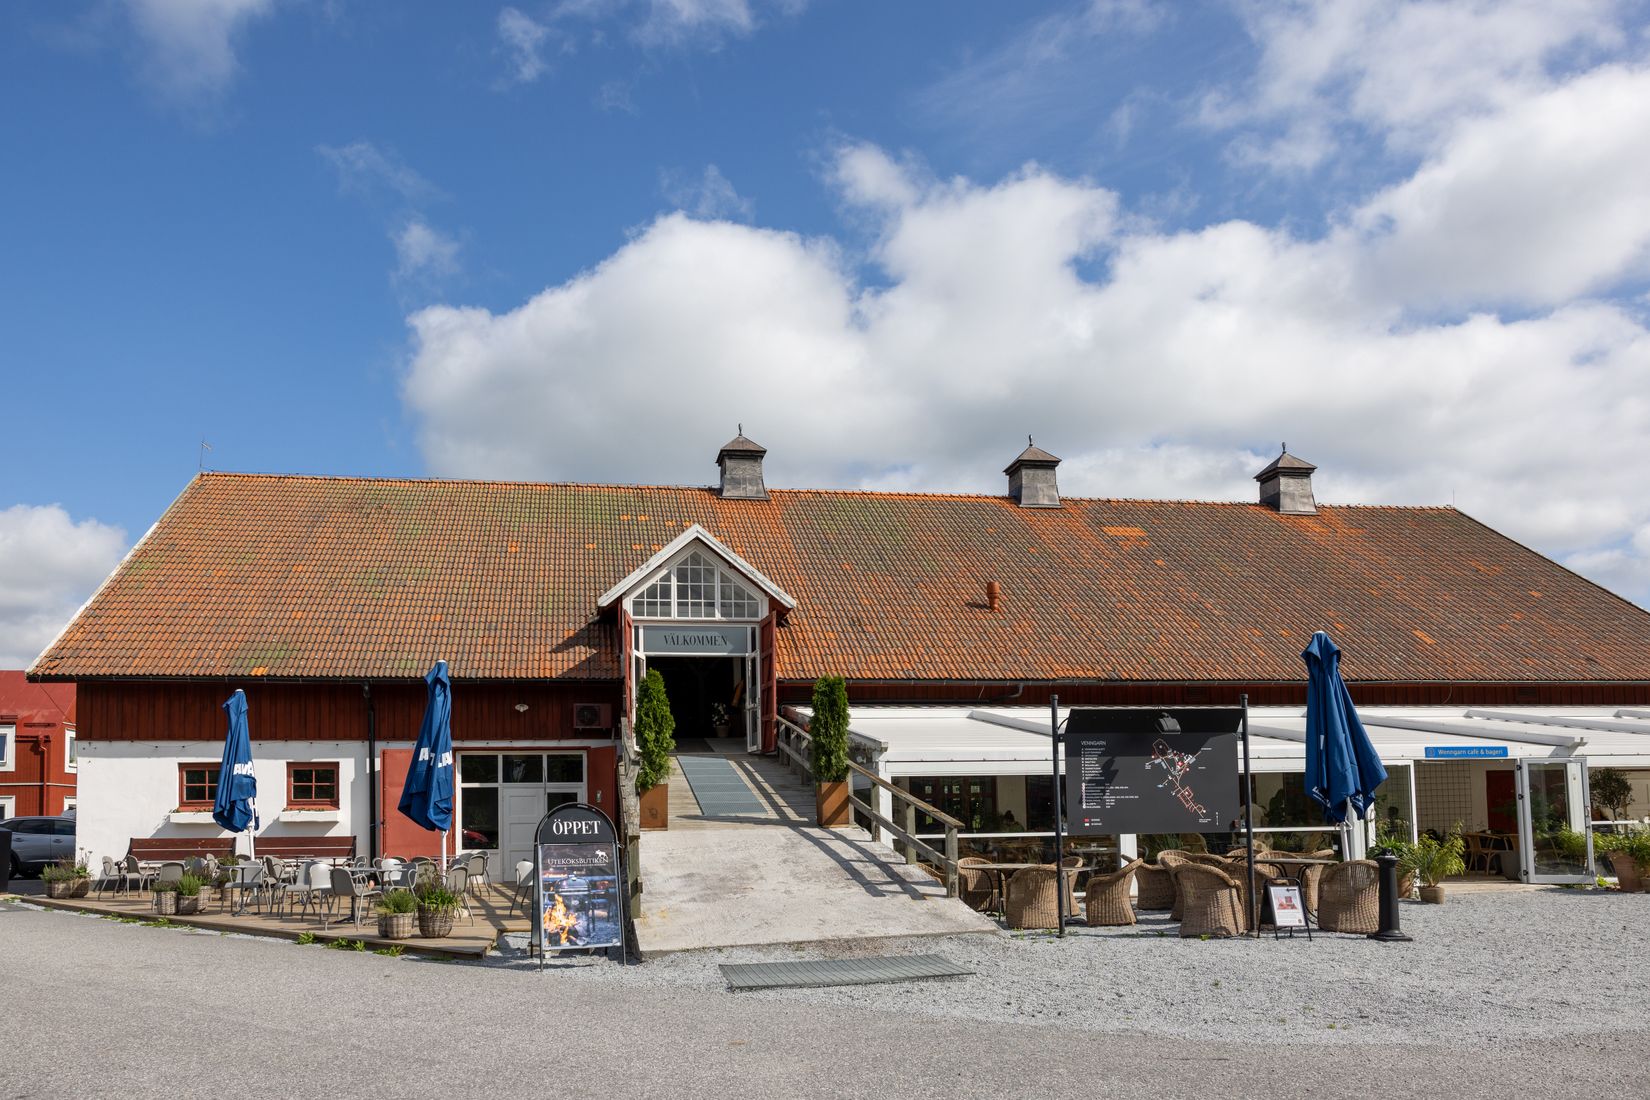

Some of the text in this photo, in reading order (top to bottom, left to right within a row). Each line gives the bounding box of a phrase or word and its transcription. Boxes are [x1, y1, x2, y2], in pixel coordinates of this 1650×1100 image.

[664, 633, 728, 646] VÄLKOMMEN
[1438, 748, 1466, 757] Wenngarn
[1485, 747, 1504, 757] bageri
[553, 819, 600, 835] ÖPPET
